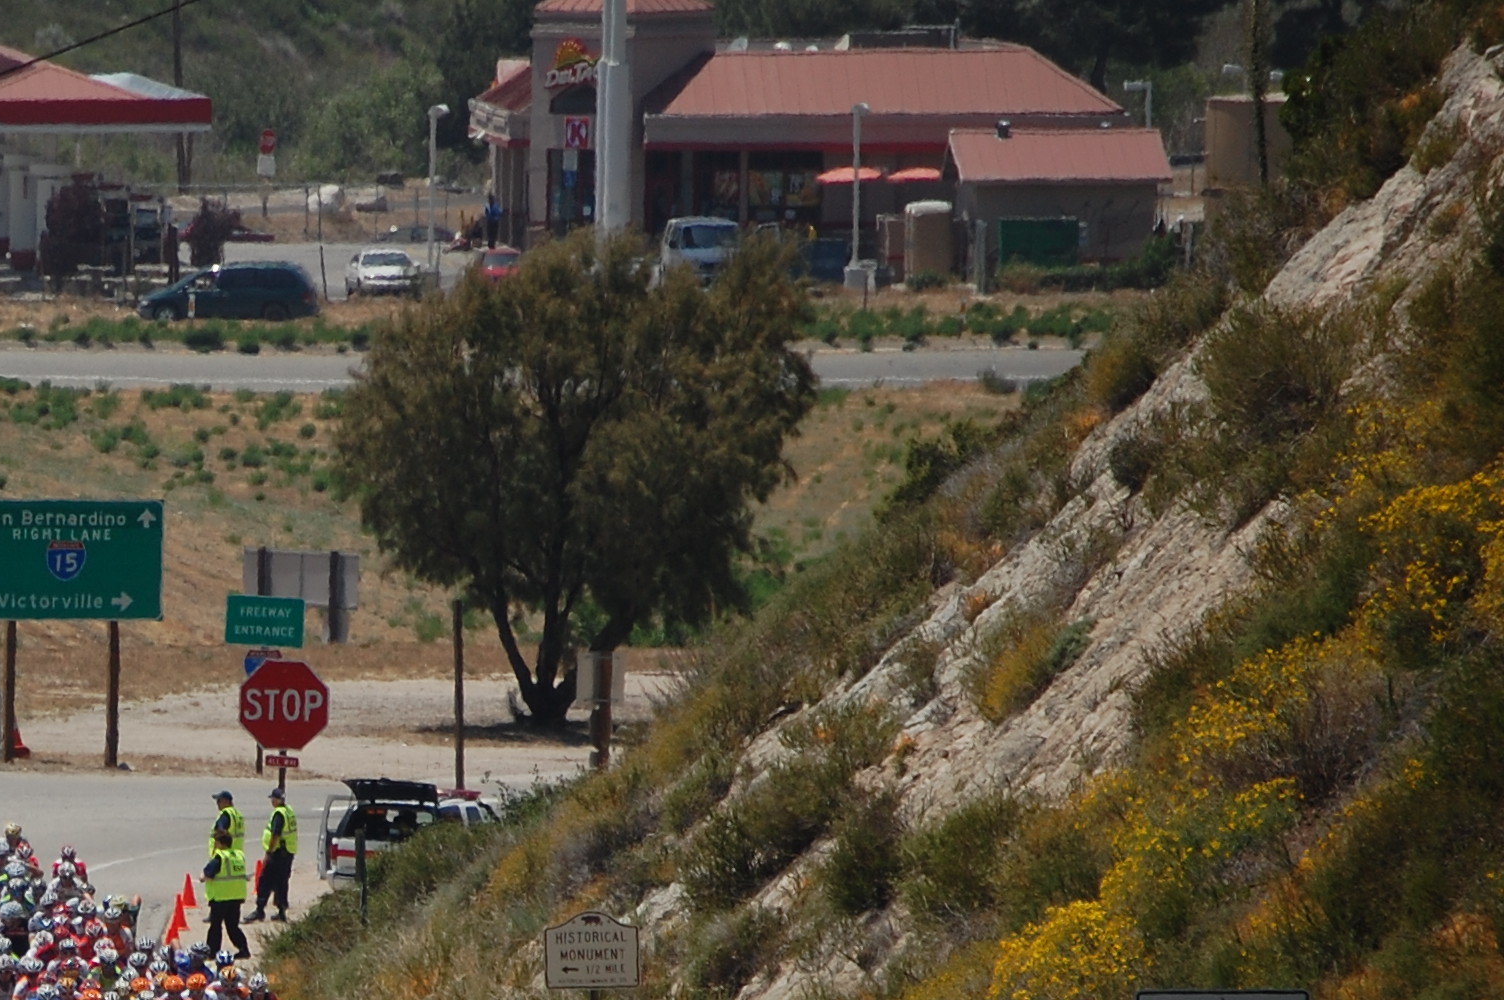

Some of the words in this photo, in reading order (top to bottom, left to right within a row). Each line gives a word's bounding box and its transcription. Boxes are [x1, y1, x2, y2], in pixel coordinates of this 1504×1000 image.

[22, 509, 127, 526] Bernardino
[12, 528, 61, 540] RIGHT
[70, 528, 112, 541] LANE
[55, 552, 78, 572] 15
[240, 605, 292, 618] FREEWAY
[234, 625, 295, 638] ENTRANCE
[243, 688, 323, 722] STOP
[555, 931, 627, 944] HISTORICAL
[560, 948, 625, 961] MONUMENT
[586, 964, 601, 975] 1/2
[605, 963, 625, 974] MILE
